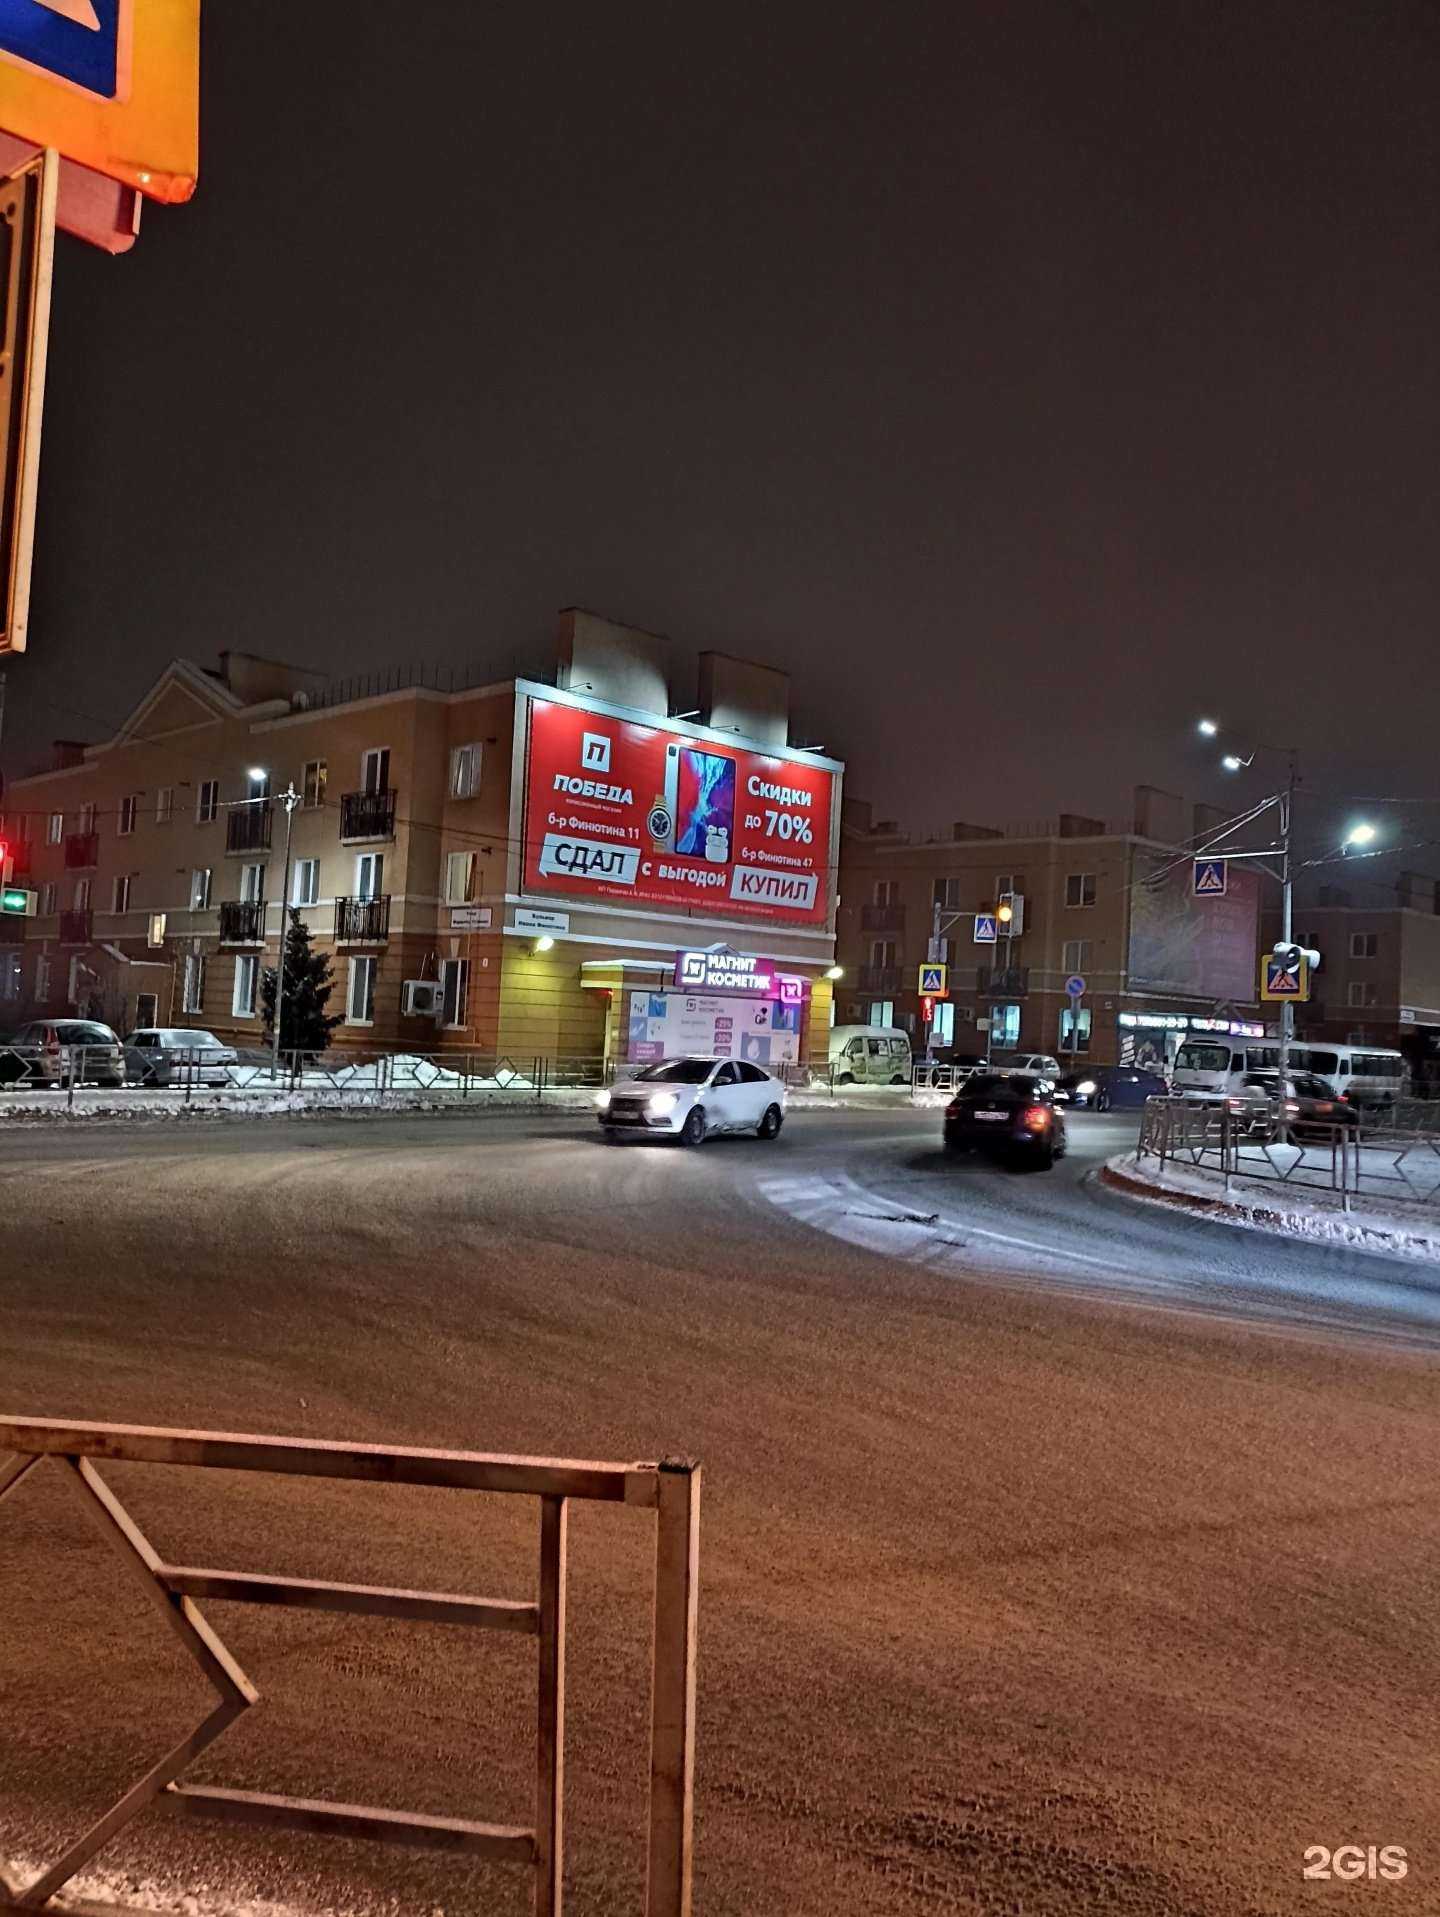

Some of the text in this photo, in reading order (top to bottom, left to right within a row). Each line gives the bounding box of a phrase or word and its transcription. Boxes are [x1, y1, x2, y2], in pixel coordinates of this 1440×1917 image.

[553, 774, 633, 805] ПОБЕДА
[748, 776, 812, 806] Скидки
[548, 812, 640, 840] б-р Финютина 11
[744, 810, 813, 844] до 70%
[554, 843, 625, 875] СДАЛ
[741, 847, 757, 861] б-р
[757, 850, 802, 867] Финютина
[658, 864, 727, 888] выгодой
[740, 873, 809, 901] КУПИЛ
[708, 955, 757, 972] МАГНИТ
[707, 972, 771, 989] КОСМЕТИК
